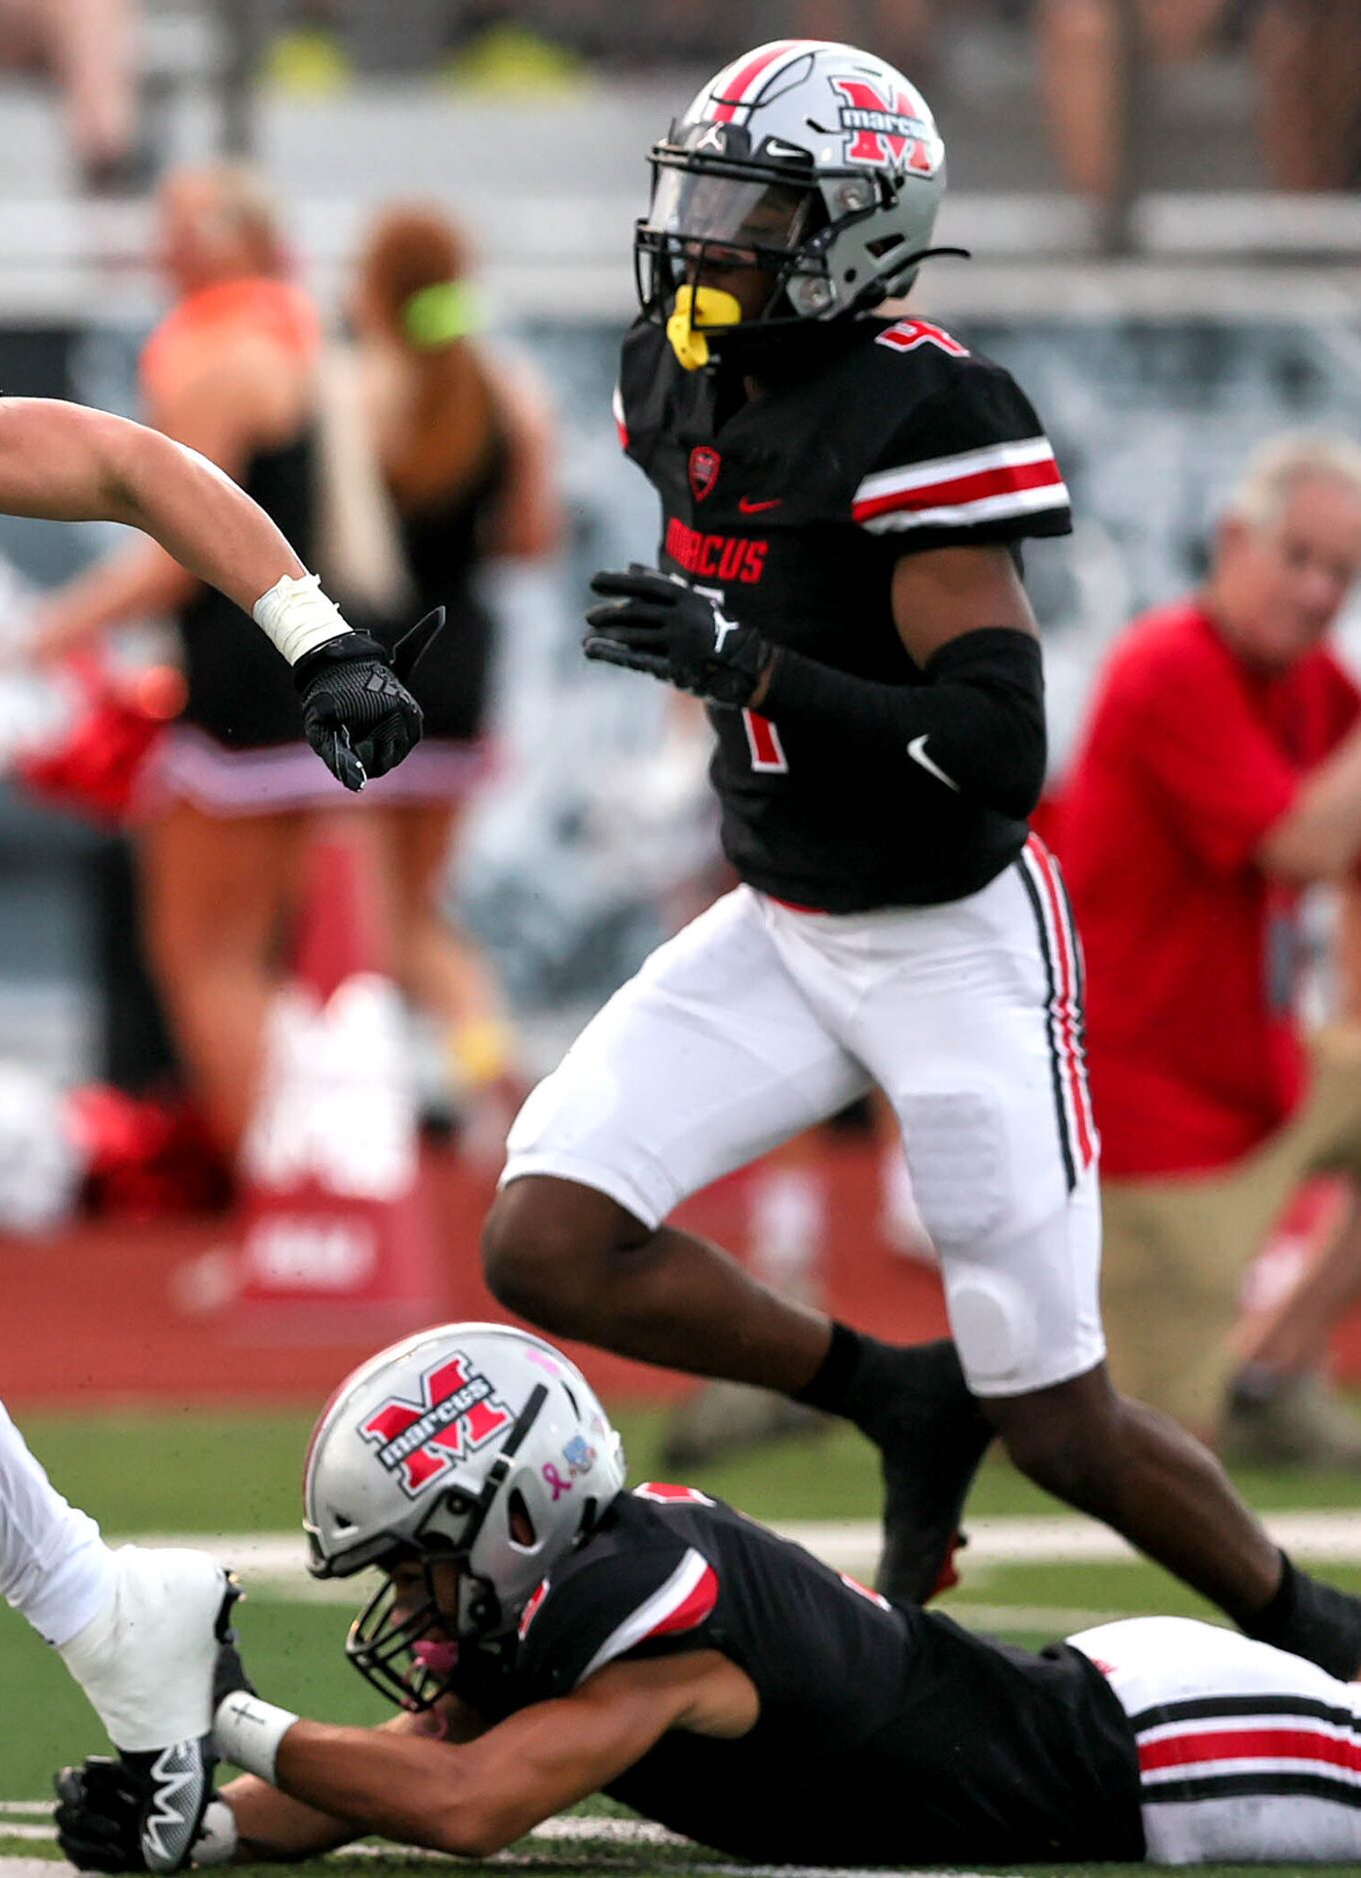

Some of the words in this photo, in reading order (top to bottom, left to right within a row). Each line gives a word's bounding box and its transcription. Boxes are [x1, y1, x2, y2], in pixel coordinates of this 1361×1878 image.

[827, 75, 936, 181] M
[840, 108, 929, 138] marc
[356, 1350, 516, 1501] M
[379, 1379, 490, 1467] marcus
